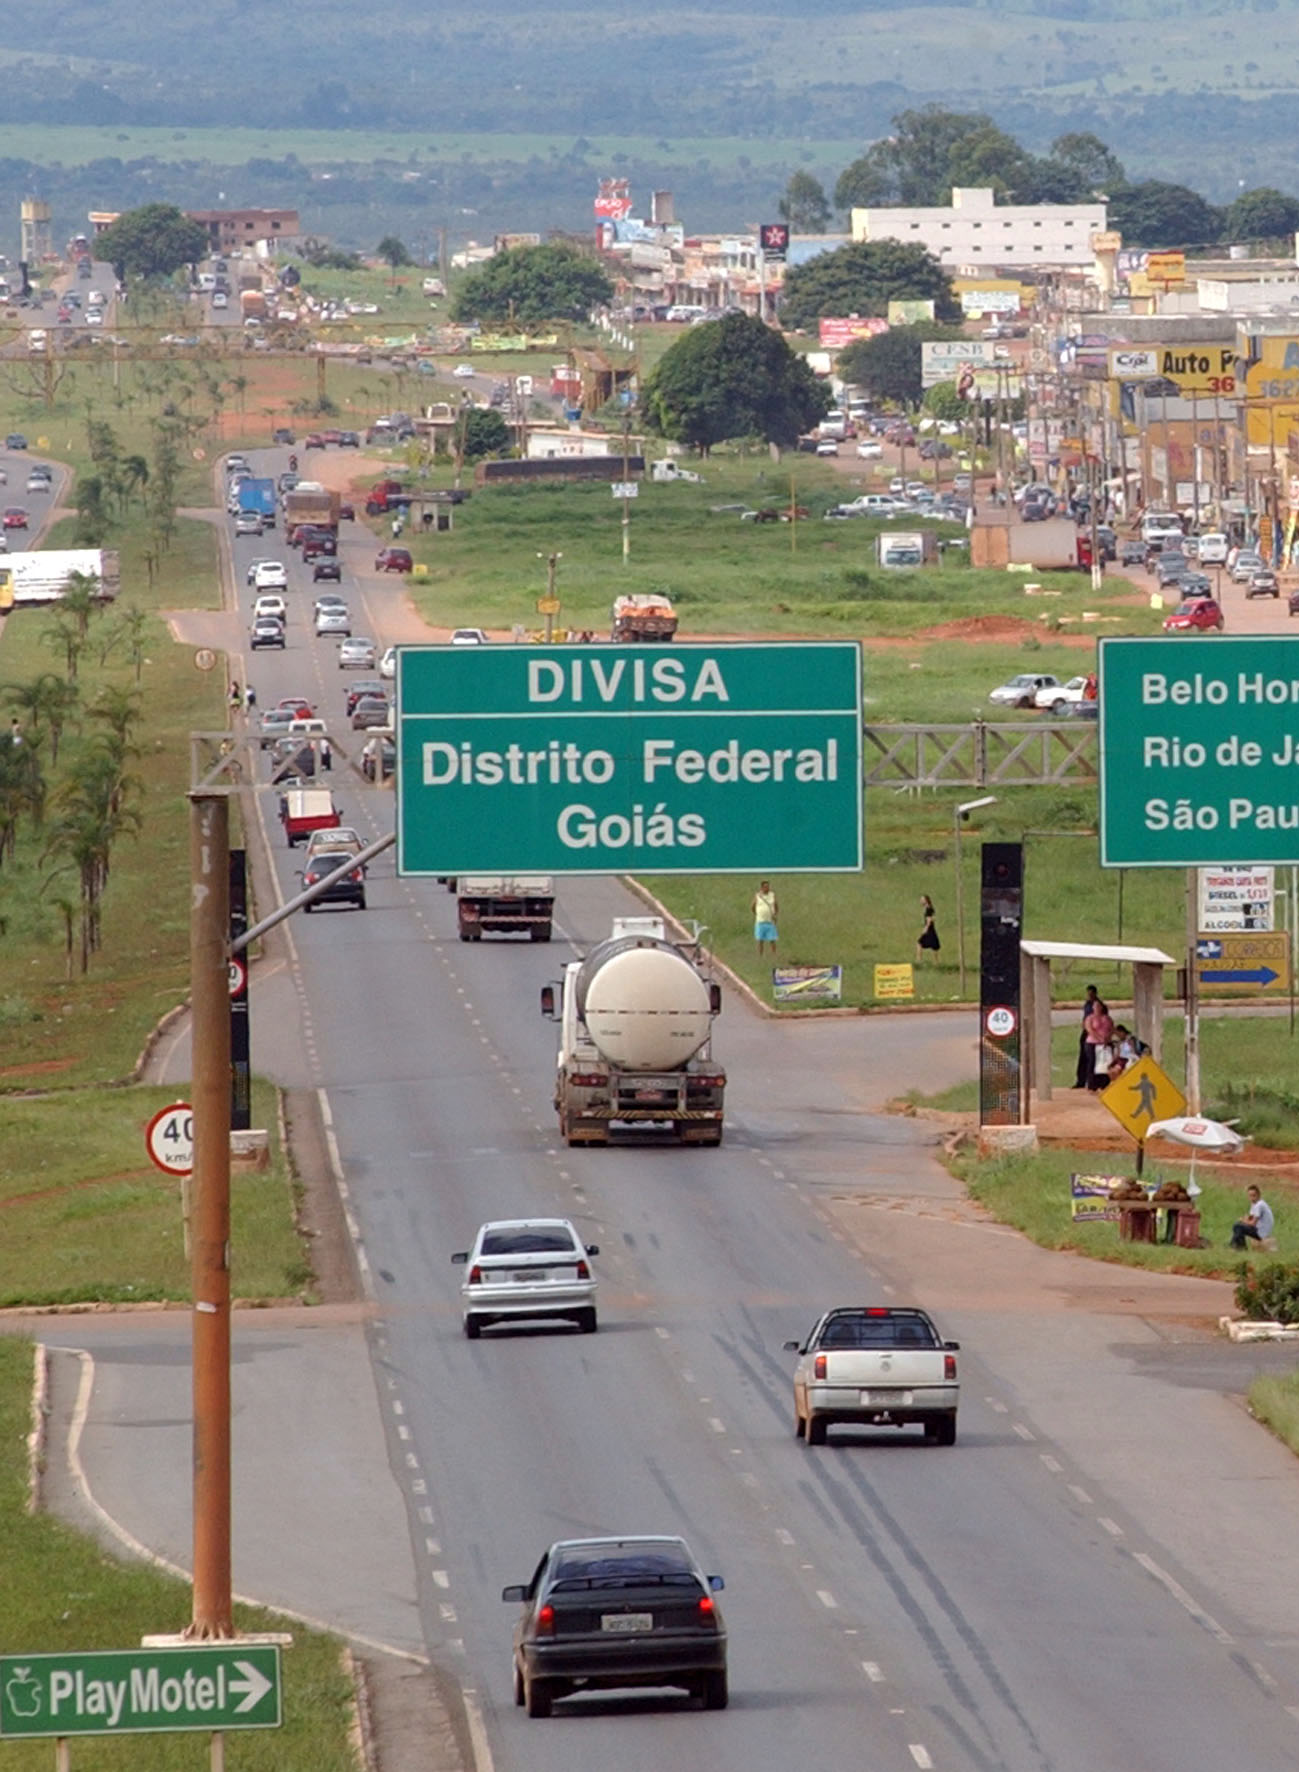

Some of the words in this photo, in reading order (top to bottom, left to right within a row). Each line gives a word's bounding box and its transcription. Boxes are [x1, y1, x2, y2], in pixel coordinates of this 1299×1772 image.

[1163, 351, 1210, 374] Auto
[527, 658, 729, 702] DIVISA
[1142, 672, 1229, 705] Belo
[422, 741, 615, 785] Distrito
[643, 739, 838, 783] Federal
[1143, 736, 1207, 768] Rio
[1216, 736, 1263, 767] de
[557, 803, 706, 848] Goiás
[1144, 799, 1219, 831] São
[992, 1012, 1009, 1024] 40
